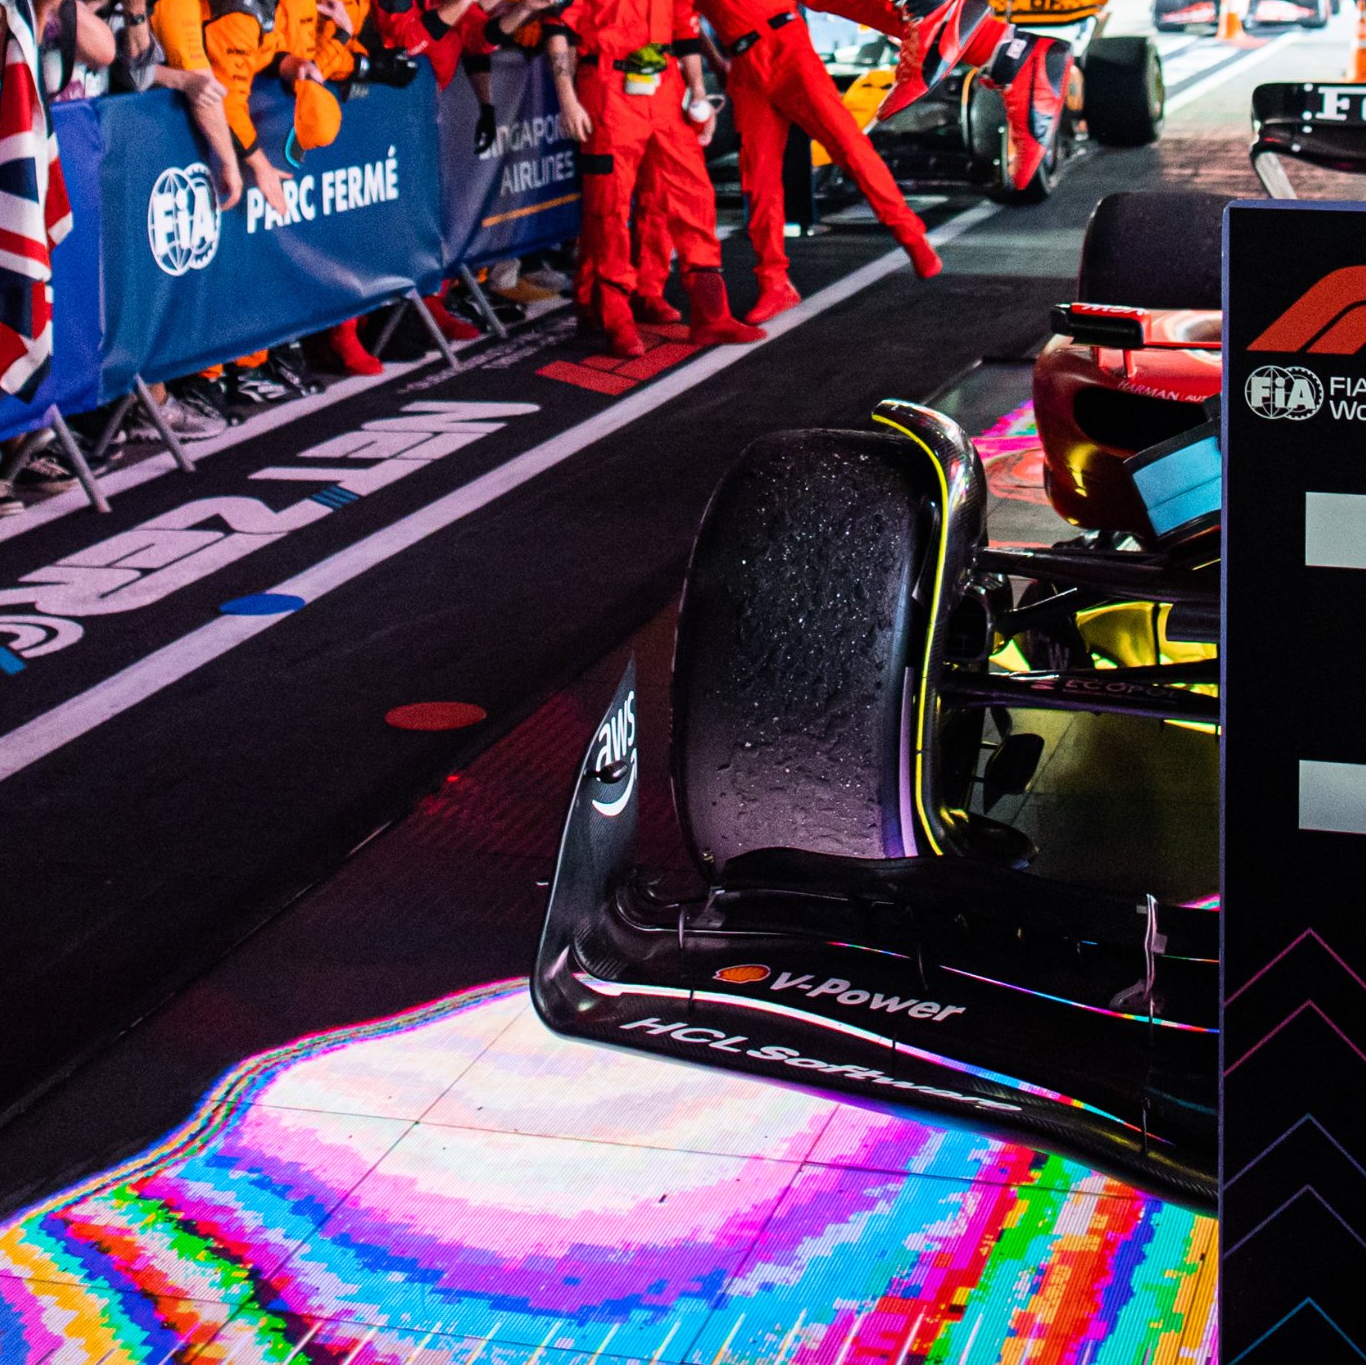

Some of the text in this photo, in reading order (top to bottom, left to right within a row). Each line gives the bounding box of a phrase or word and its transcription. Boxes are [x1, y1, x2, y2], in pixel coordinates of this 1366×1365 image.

[322, 144, 399, 216] FERMÉ
[499, 151, 575, 197] AIRLINES
[1117, 379, 1179, 402] HARMAN
[769, 971, 966, 1024] V-Power
